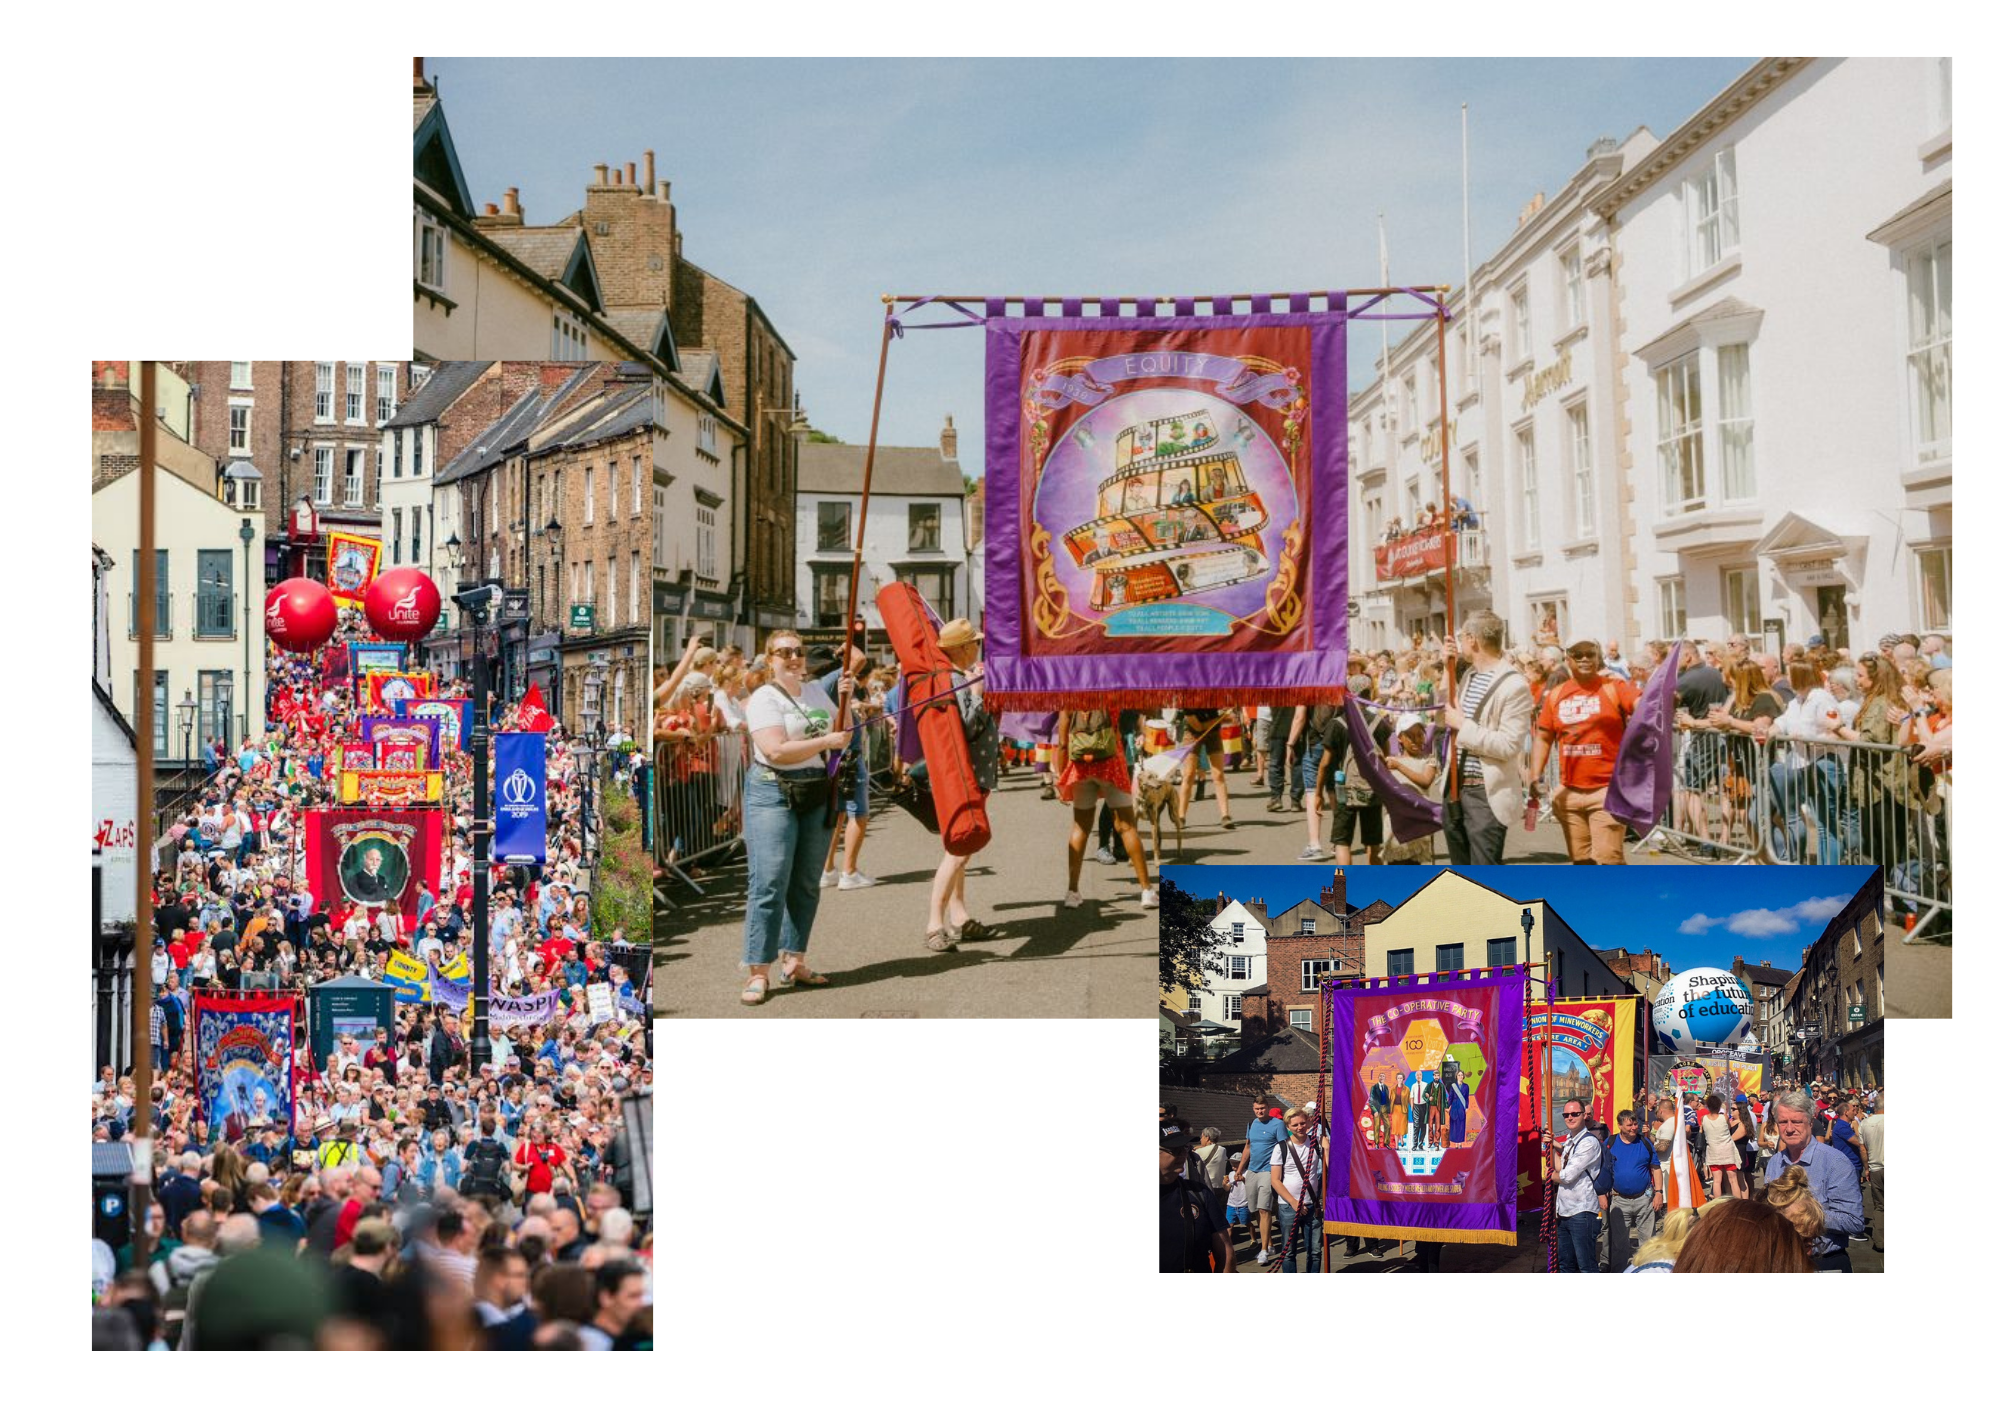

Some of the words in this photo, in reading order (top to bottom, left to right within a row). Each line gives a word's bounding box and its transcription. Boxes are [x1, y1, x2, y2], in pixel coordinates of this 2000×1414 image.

[1125, 353, 1208, 375] EQUITY
[1683, 989, 1711, 1003] the
[1371, 1015, 1386, 1026] THE
[1387, 1000, 1450, 1020] CO-OPERATIVE
[1451, 1004, 1480, 1020] PARTY
[1678, 1004, 1695, 1019] of
[1698, 1001, 1754, 1016] educatio
[1530, 1015, 1546, 1025] NION
[1559, 1015, 1604, 1039] MINEWORKERS
[1405, 1039, 1423, 1050] 100
[1563, 1035, 1582, 1047] AREA
